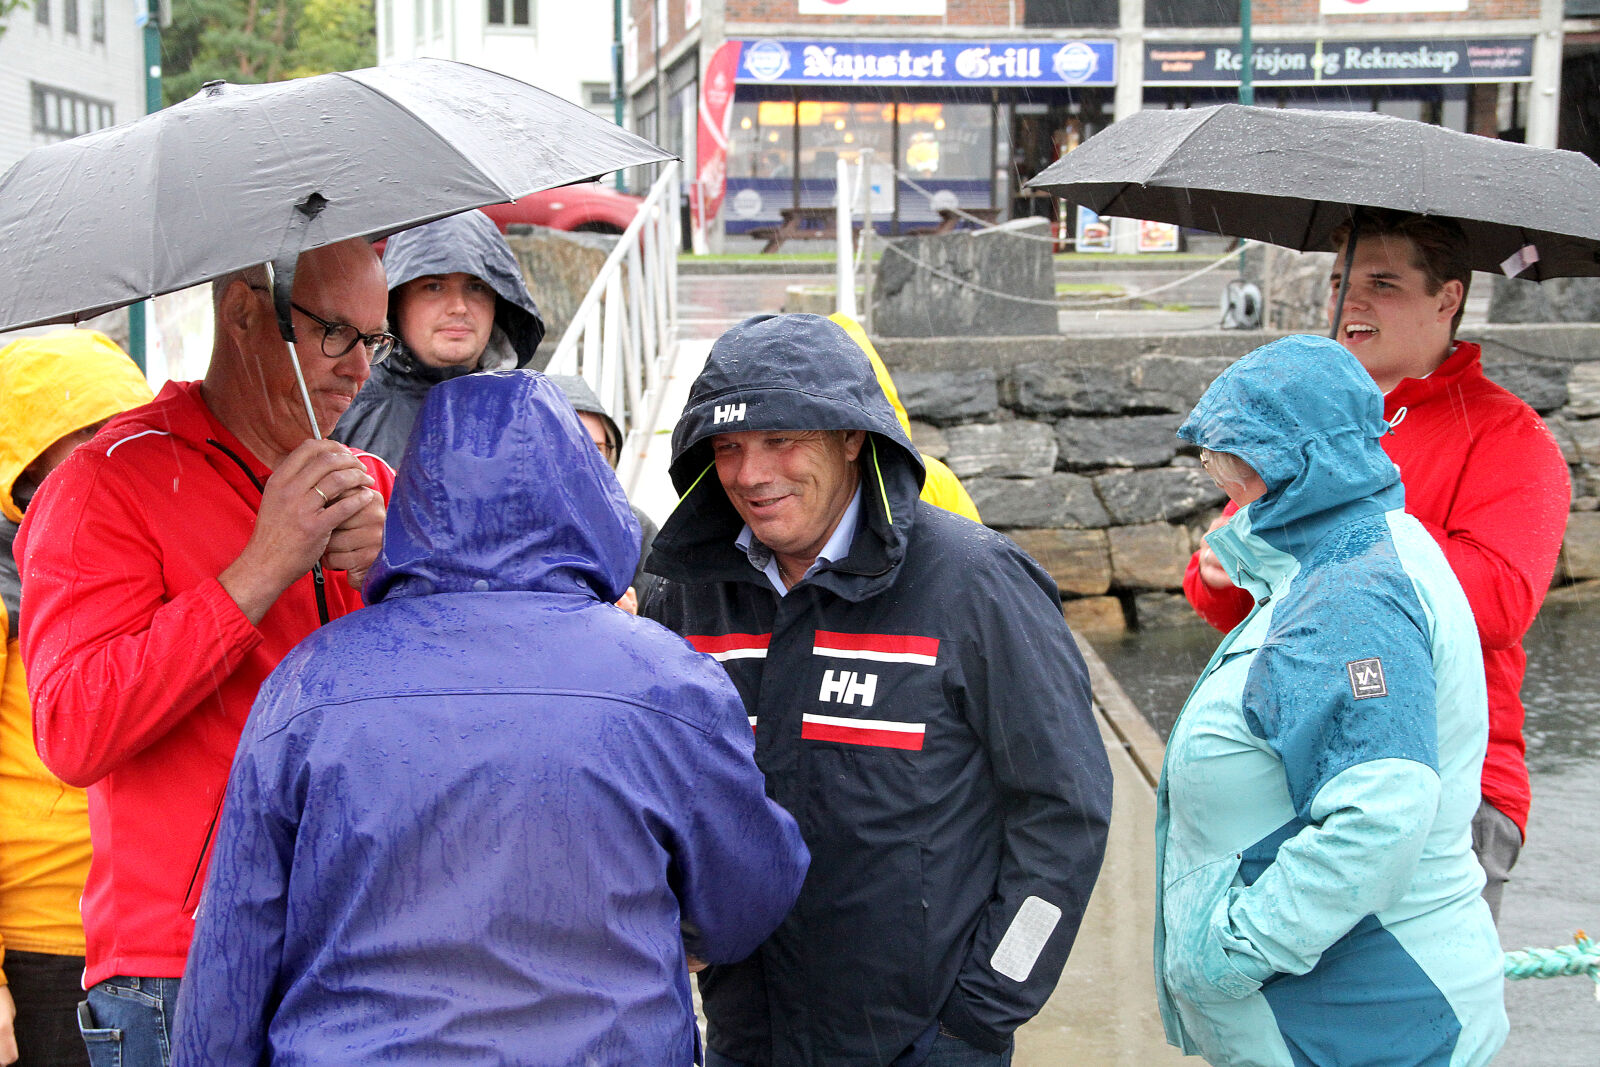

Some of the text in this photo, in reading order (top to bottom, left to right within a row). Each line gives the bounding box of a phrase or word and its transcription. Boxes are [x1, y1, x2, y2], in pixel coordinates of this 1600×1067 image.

[955, 47, 1042, 78] Grill
[1310, 53, 1340, 75] og
[1344, 46, 1459, 73] Rekneskap
[713, 403, 746, 425] HH
[818, 669, 878, 707] HH
